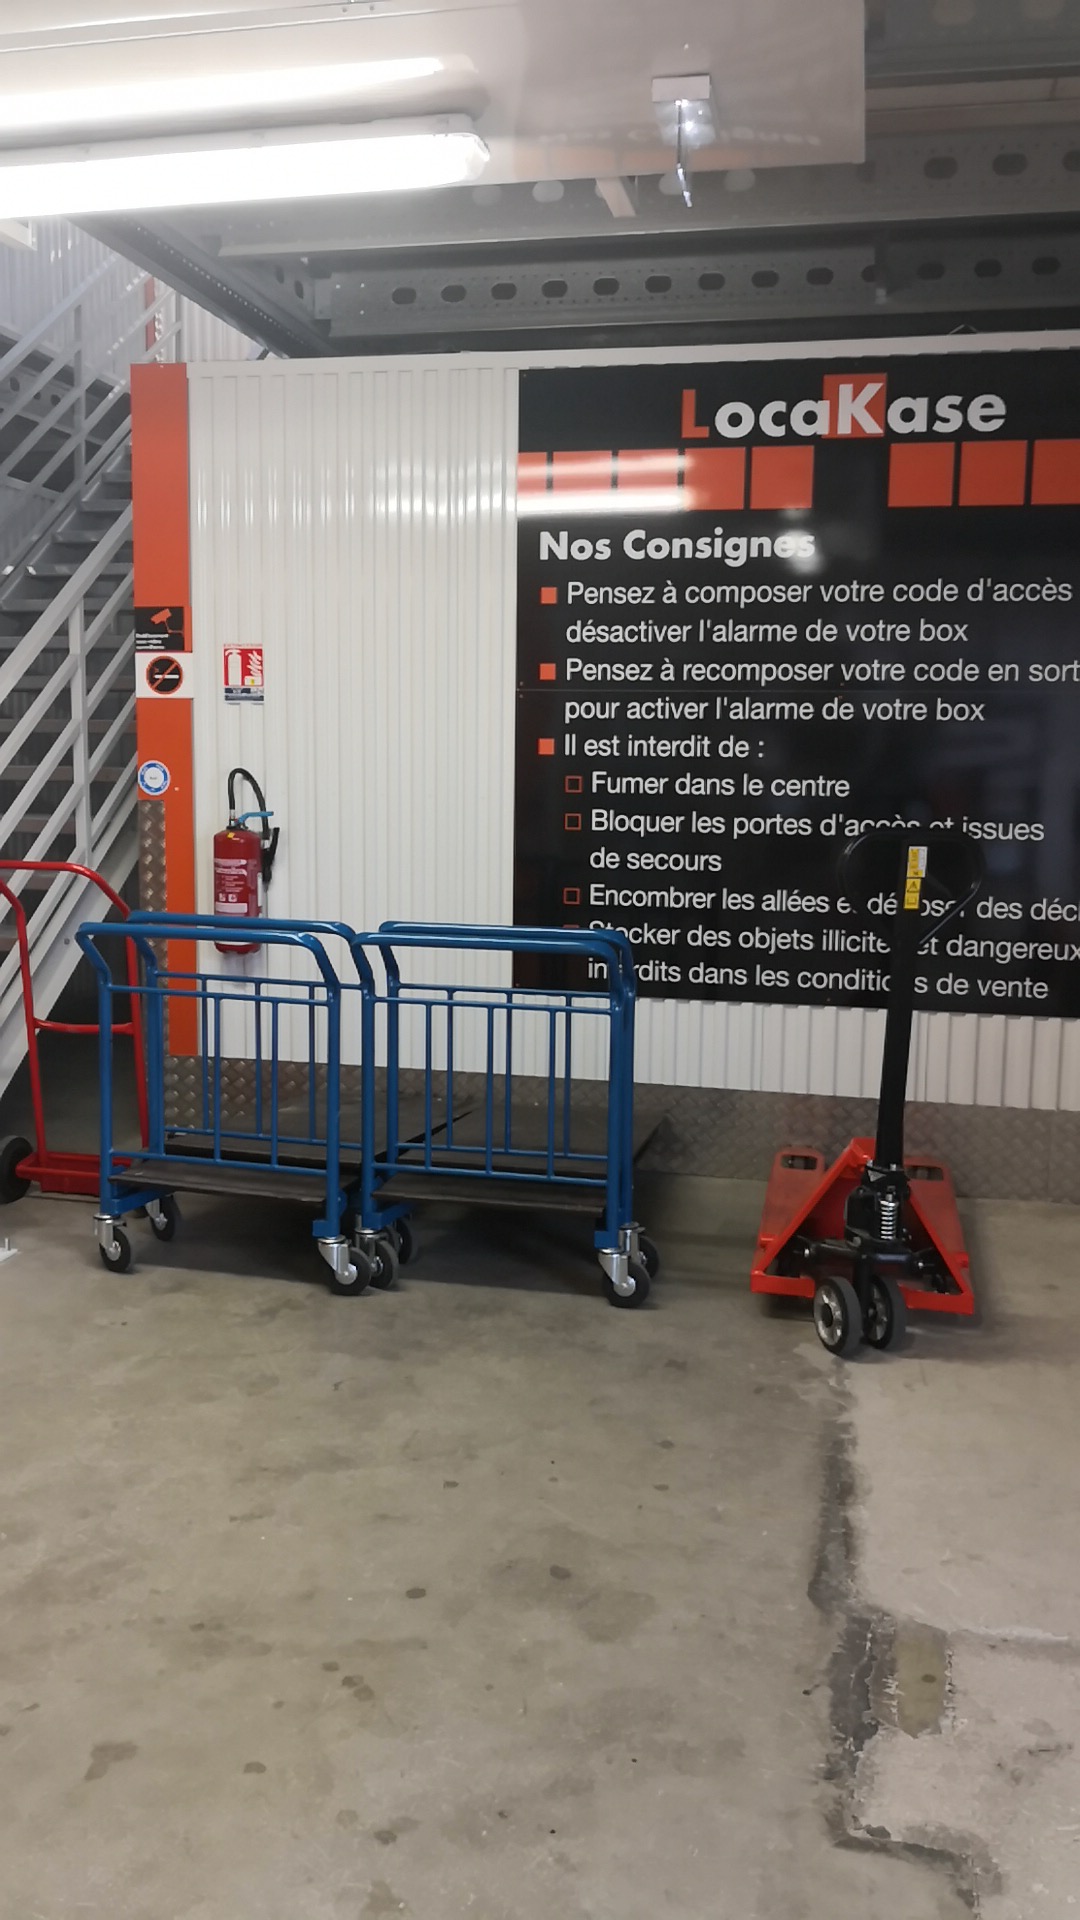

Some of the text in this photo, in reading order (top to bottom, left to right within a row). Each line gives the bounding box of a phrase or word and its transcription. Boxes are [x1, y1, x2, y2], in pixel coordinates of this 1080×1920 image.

[681, 382, 1006, 439] LocaKase
[540, 527, 815, 566] Nos Consignes
[568, 578, 1071, 608] Pensez à composer votre code d'accès
[566, 619, 968, 643] désactiver l'alarme de votre box
[567, 658, 653, 681] Pensez
[660, 664, 674, 681] à
[683, 664, 833, 686] recomposer
[841, 660, 905, 681] votre
[914, 659, 979, 681] code
[988, 664, 1018, 681] en
[565, 697, 984, 723] pour activer l'alarme de votre box
[565, 734, 575, 755] Il
[584, 736, 620, 756] est
[628, 734, 710, 757] interdit
[719, 735, 749, 757] de
[592, 771, 849, 797] Fumer dans le centre
[592, 809, 684, 837] Bloquer
[692, 811, 725, 833] les
[734, 814, 812, 839] portes
[963, 817, 1044, 840] issues
[590, 847, 721, 871] de secours
[590, 884, 716, 908] Encombrer
[723, 888, 754, 910] les
[762, 890, 829, 912] allées
[977, 897, 1022, 919] des
[1031, 898, 1080, 921] déc
[687, 925, 731, 947] des
[739, 927, 813, 954] objets
[823, 930, 890, 953] illicite
[947, 935, 1080, 963] dangereux
[589, 958, 1048, 998] indits dans les conditios de vente
